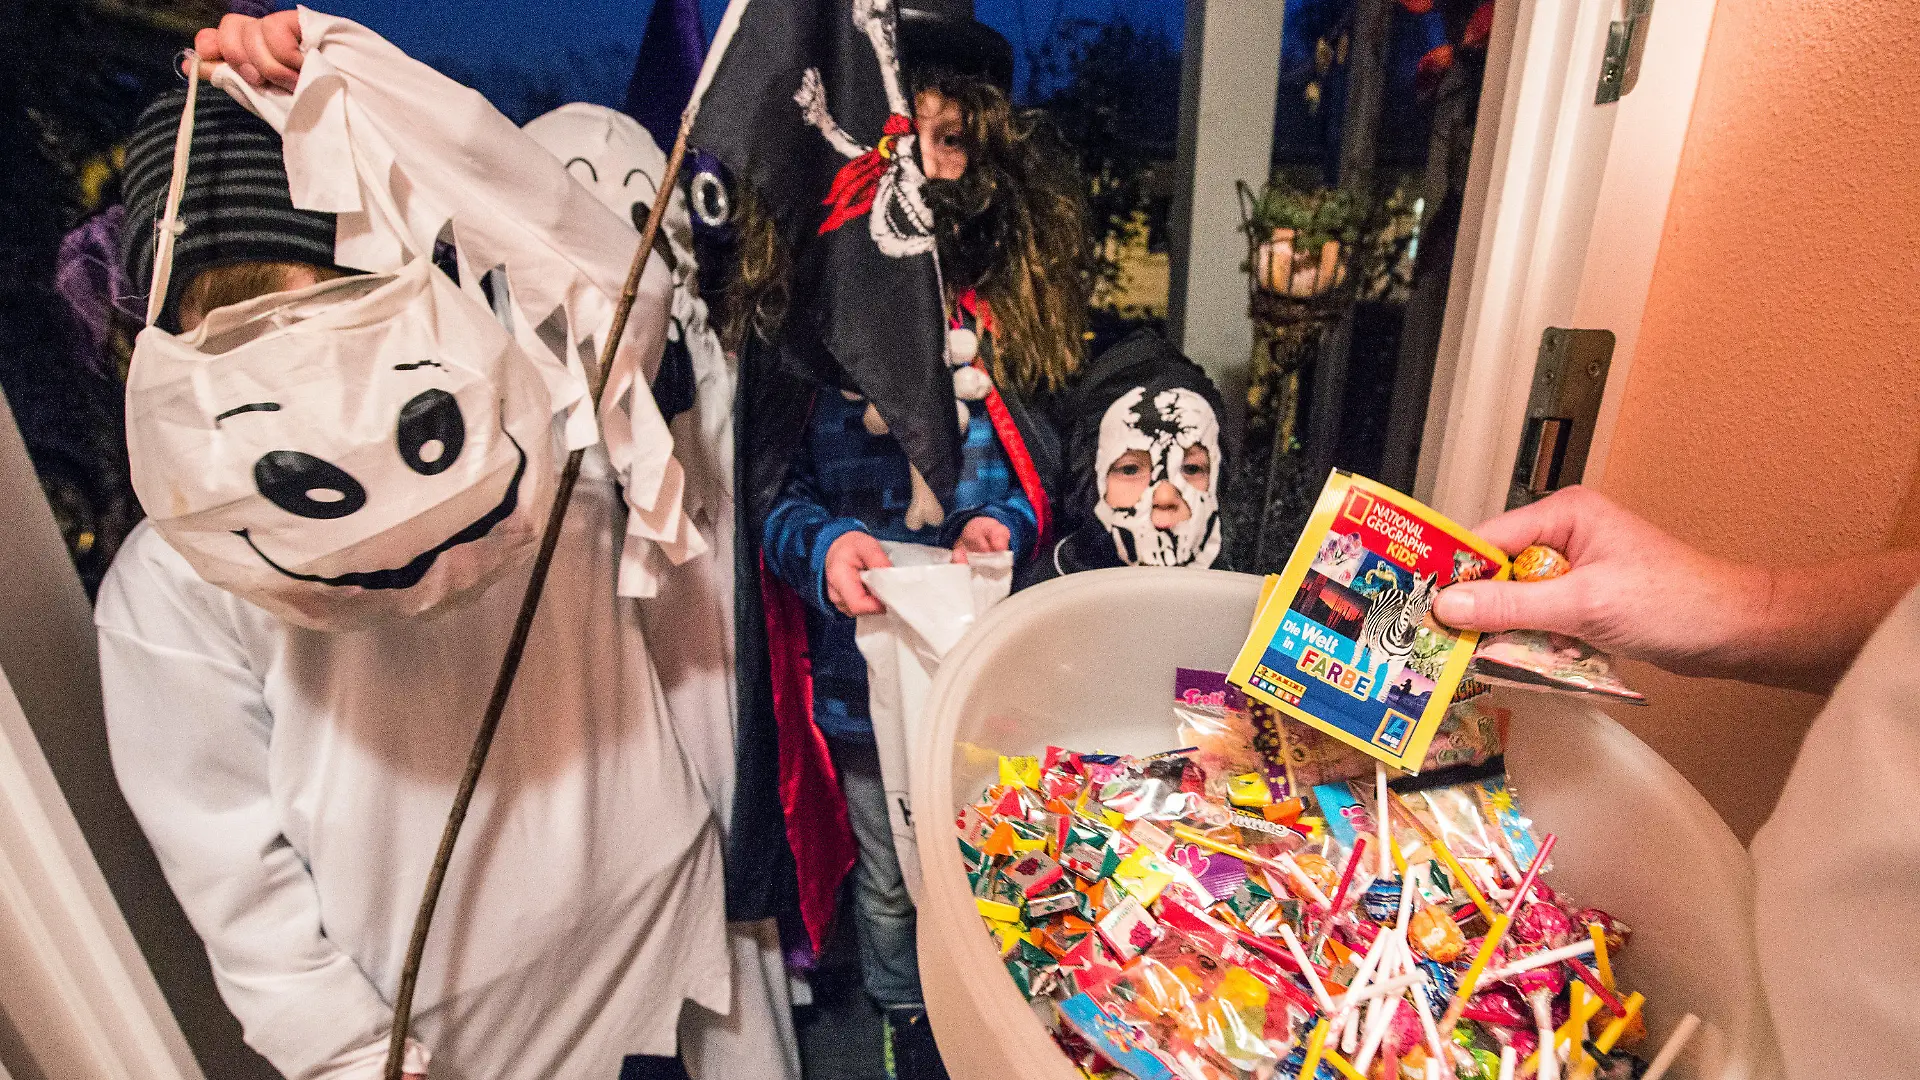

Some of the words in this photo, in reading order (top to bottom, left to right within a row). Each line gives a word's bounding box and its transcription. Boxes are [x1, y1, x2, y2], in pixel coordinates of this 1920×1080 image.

[1366, 515, 1432, 559] GEOGRAPHIC
[1373, 503, 1424, 540] NATIONAL
[1282, 619, 1300, 636] Die
[1301, 622, 1339, 654] Welt
[1282, 636, 1295, 650] in
[1271, 672, 1304, 693] PANINI
[1299, 648, 1372, 698] FARBE
